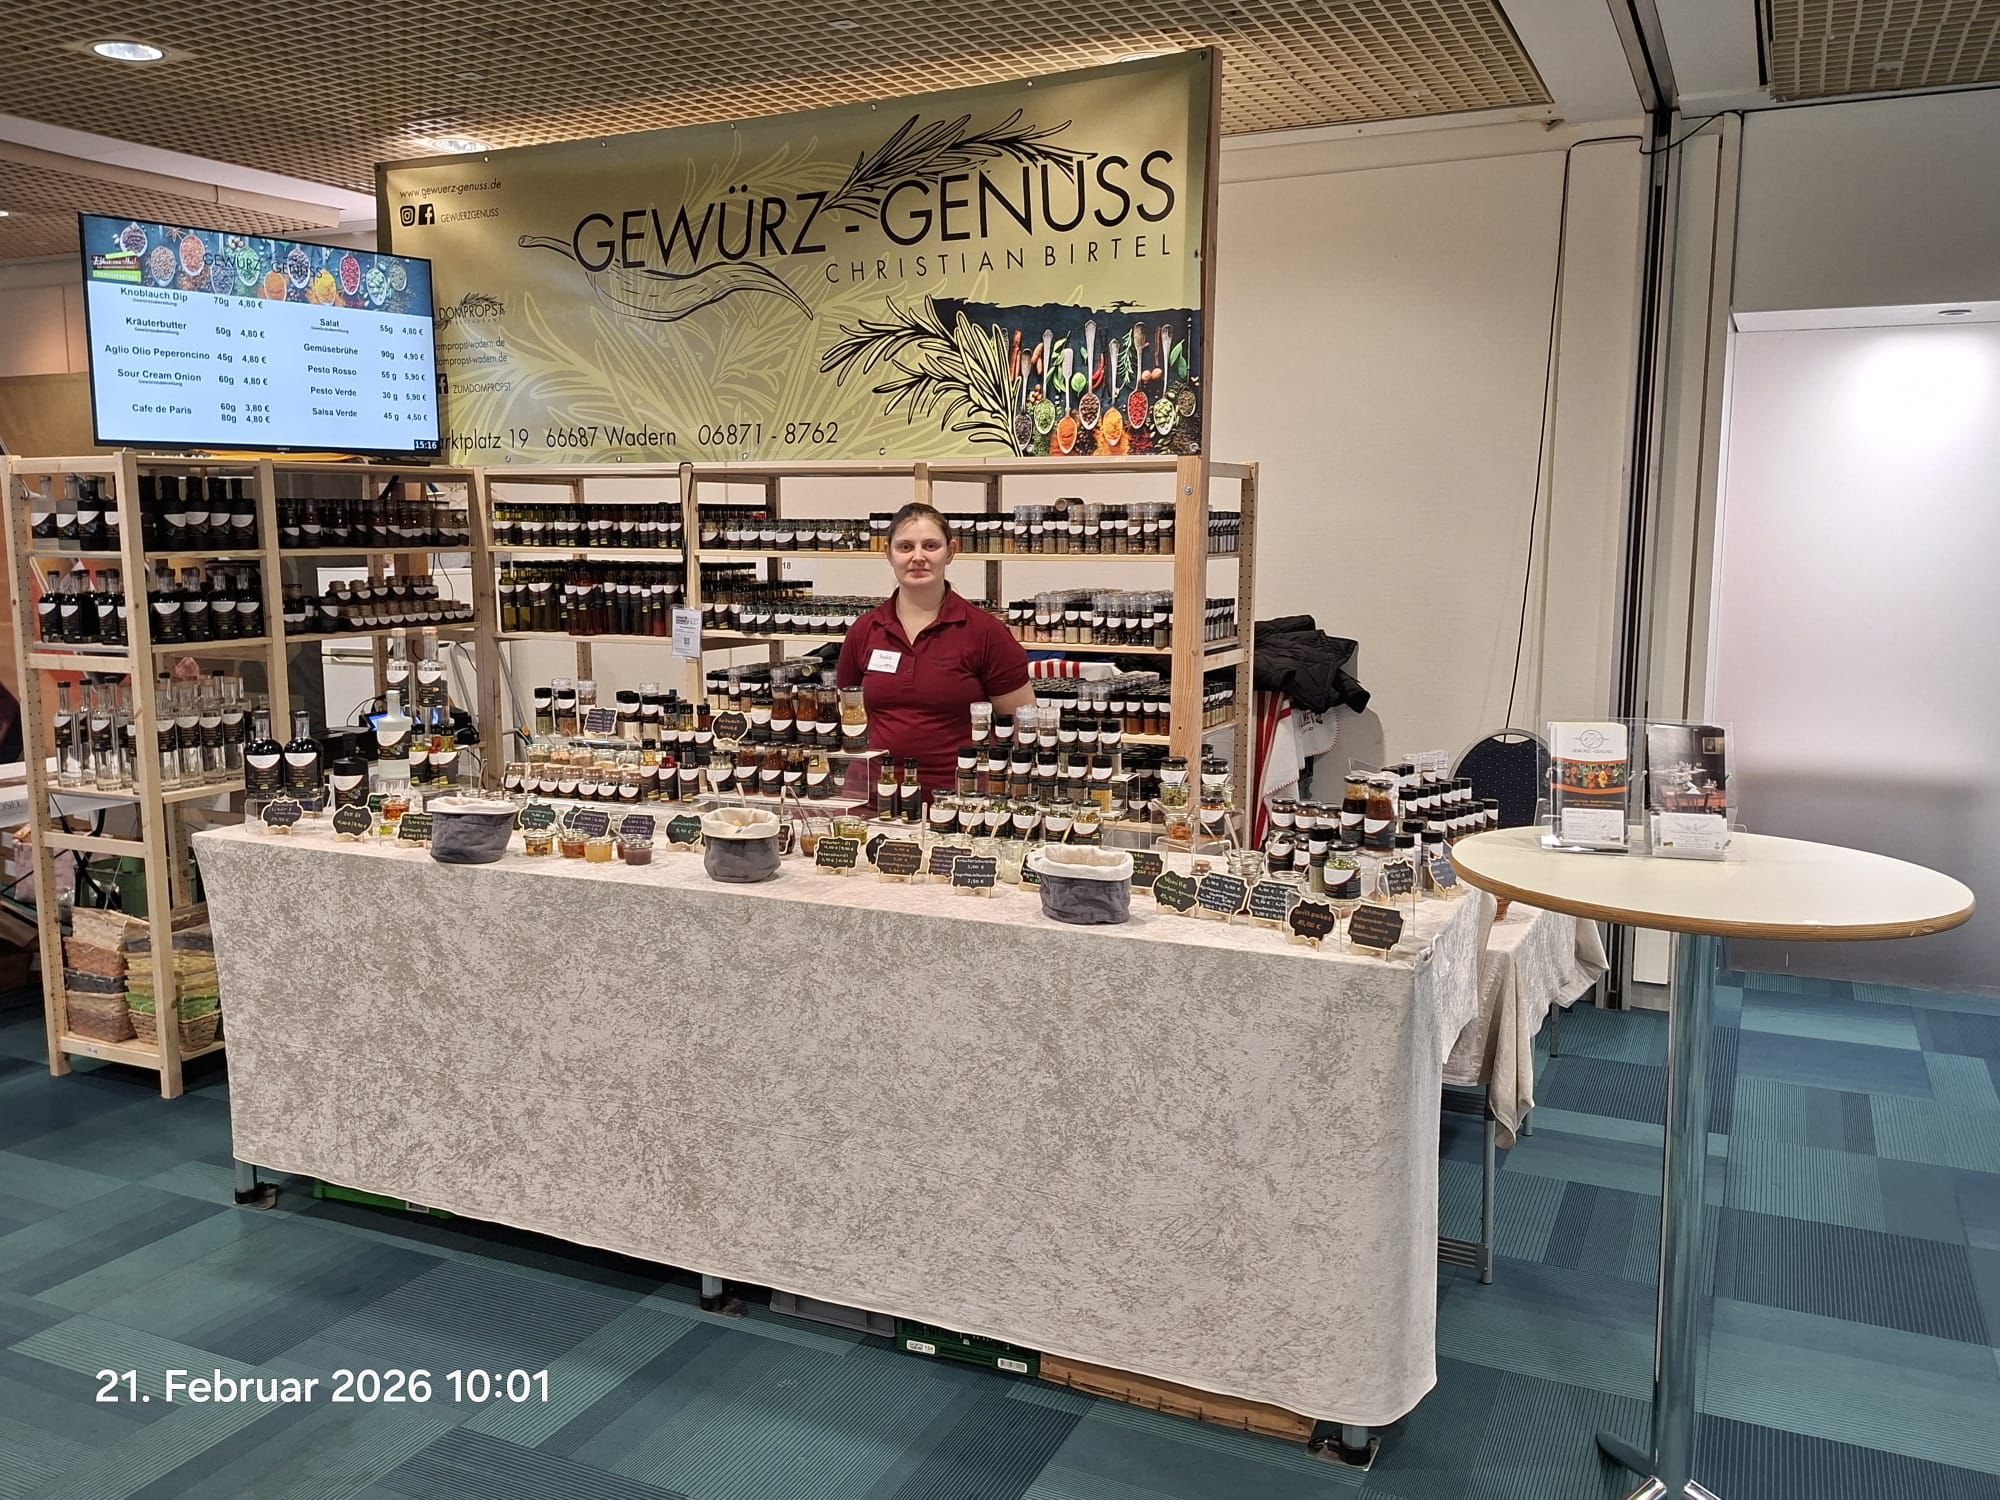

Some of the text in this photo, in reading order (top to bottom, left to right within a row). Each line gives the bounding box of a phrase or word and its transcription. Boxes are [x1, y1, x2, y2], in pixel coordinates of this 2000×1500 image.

[400, 178, 502, 199] www.gewuerz-genuss.de
[440, 207, 500, 224] GEWUERZGENUSS
[573, 184, 827, 273] GEWÜRZ
[879, 150, 1176, 246] GENUSS
[825, 233, 1171, 284] CHRISTIAN BIRTEL
[120, 287, 188, 303] Knoblauch Dip
[213, 297, 229, 307] 70g
[125, 317, 187, 331] Kräuterbutter
[320, 318, 339, 328] Salat
[215, 327, 231, 337] 50g
[379, 325, 393, 334] 55g
[104, 345, 210, 360] Aglio Olio Peperoncino
[303, 343, 359, 356] Gemüsebrühe
[217, 353, 233, 363] 45g
[261, 356, 267, 364] €
[381, 350, 395, 360] 90g
[420, 353, 425, 361] €
[117, 369, 202, 382] Sour Cream Onion
[307, 365, 357, 376] Pesto Rosso
[381, 371, 391, 379] 55
[218, 375, 234, 386] 60g
[263, 378, 268, 386] €
[310, 386, 357, 397] Pesto Verde
[392, 393, 398, 401] g
[132, 404, 192, 415] Cafe de Paris
[220, 403, 236, 413] 60g
[264, 404, 270, 413] €
[312, 407, 358, 418] Salsa Verde
[221, 414, 237, 424] 80g
[265, 415, 271, 424] €
[383, 412, 393, 420] 45
[509, 428, 530, 448] 19
[546, 426, 599, 448] 66687
[604, 425, 677, 447] Wadern
[698, 424, 762, 446] 06871
[783, 421, 839, 445] 8762
[414, 440, 437, 449] 15:16
